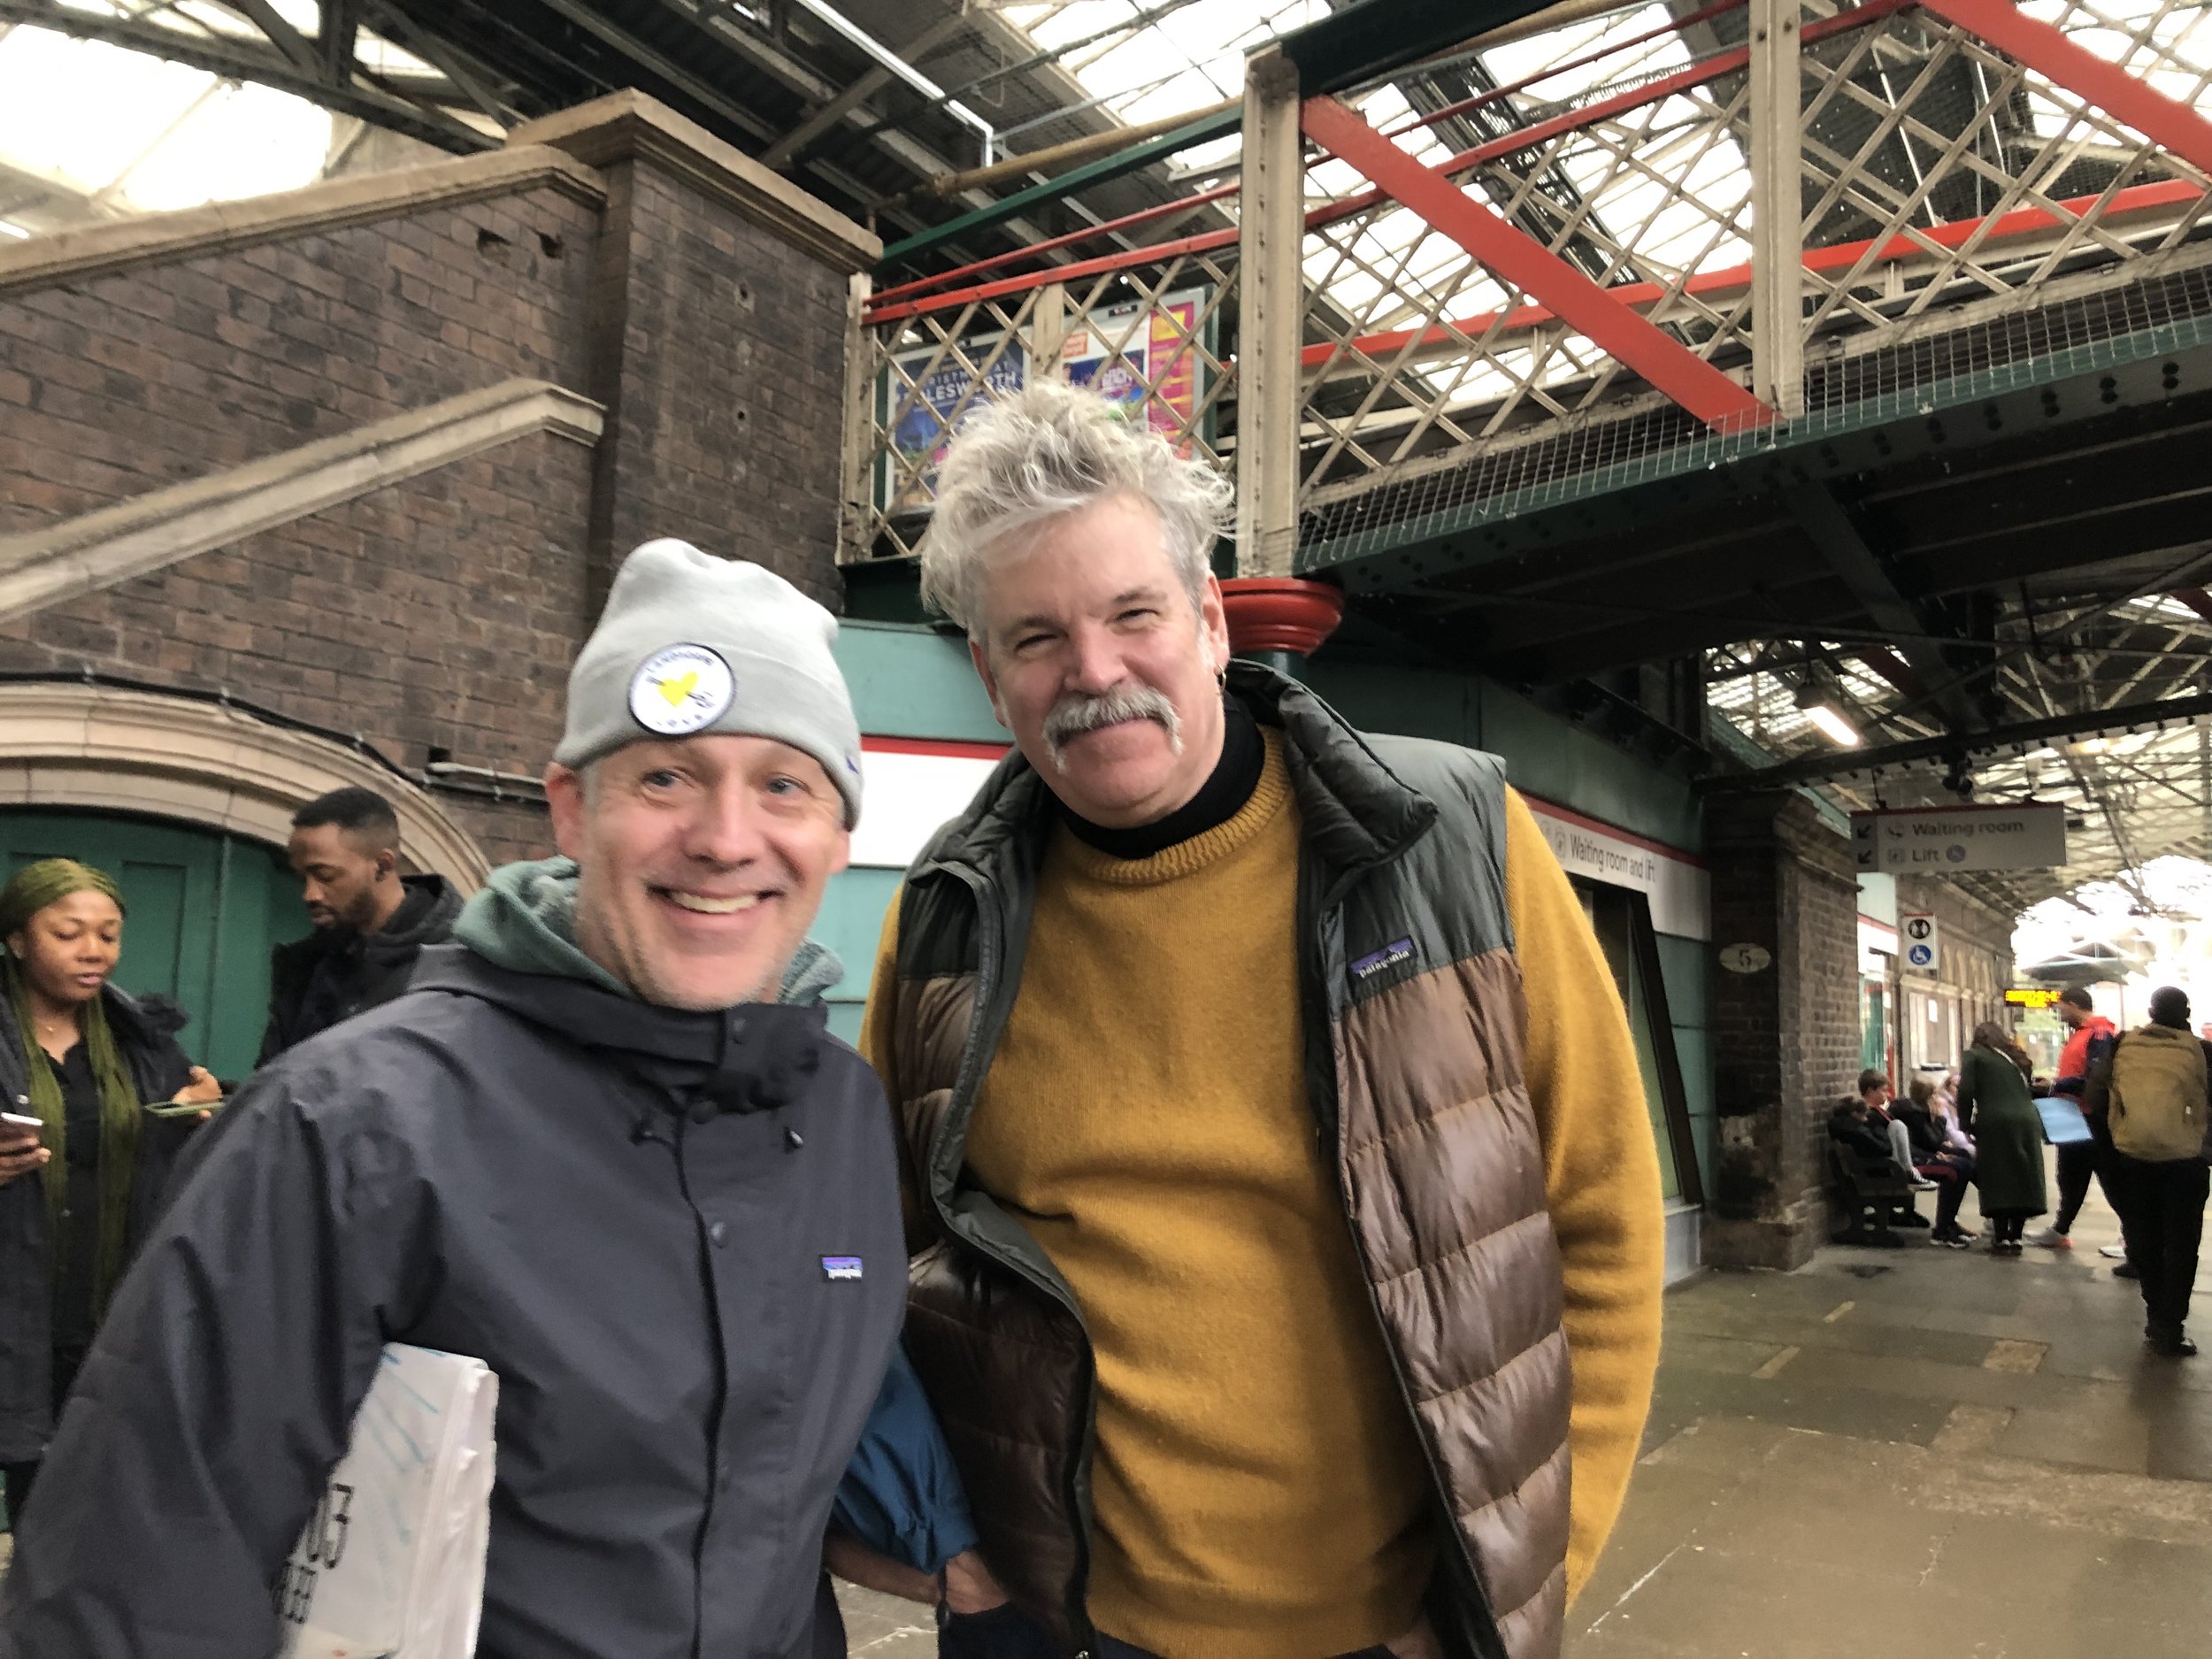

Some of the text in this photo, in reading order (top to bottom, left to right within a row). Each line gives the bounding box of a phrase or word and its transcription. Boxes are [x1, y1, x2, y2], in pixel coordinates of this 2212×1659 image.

[1912, 822, 2024, 838] Waiting room
[1570, 833, 1655, 883] Waiting room and lift
[1912, 849, 1939, 862] Lift
[1359, 950, 1409, 979] patagonia
[1740, 949, 1752, 969] 5
